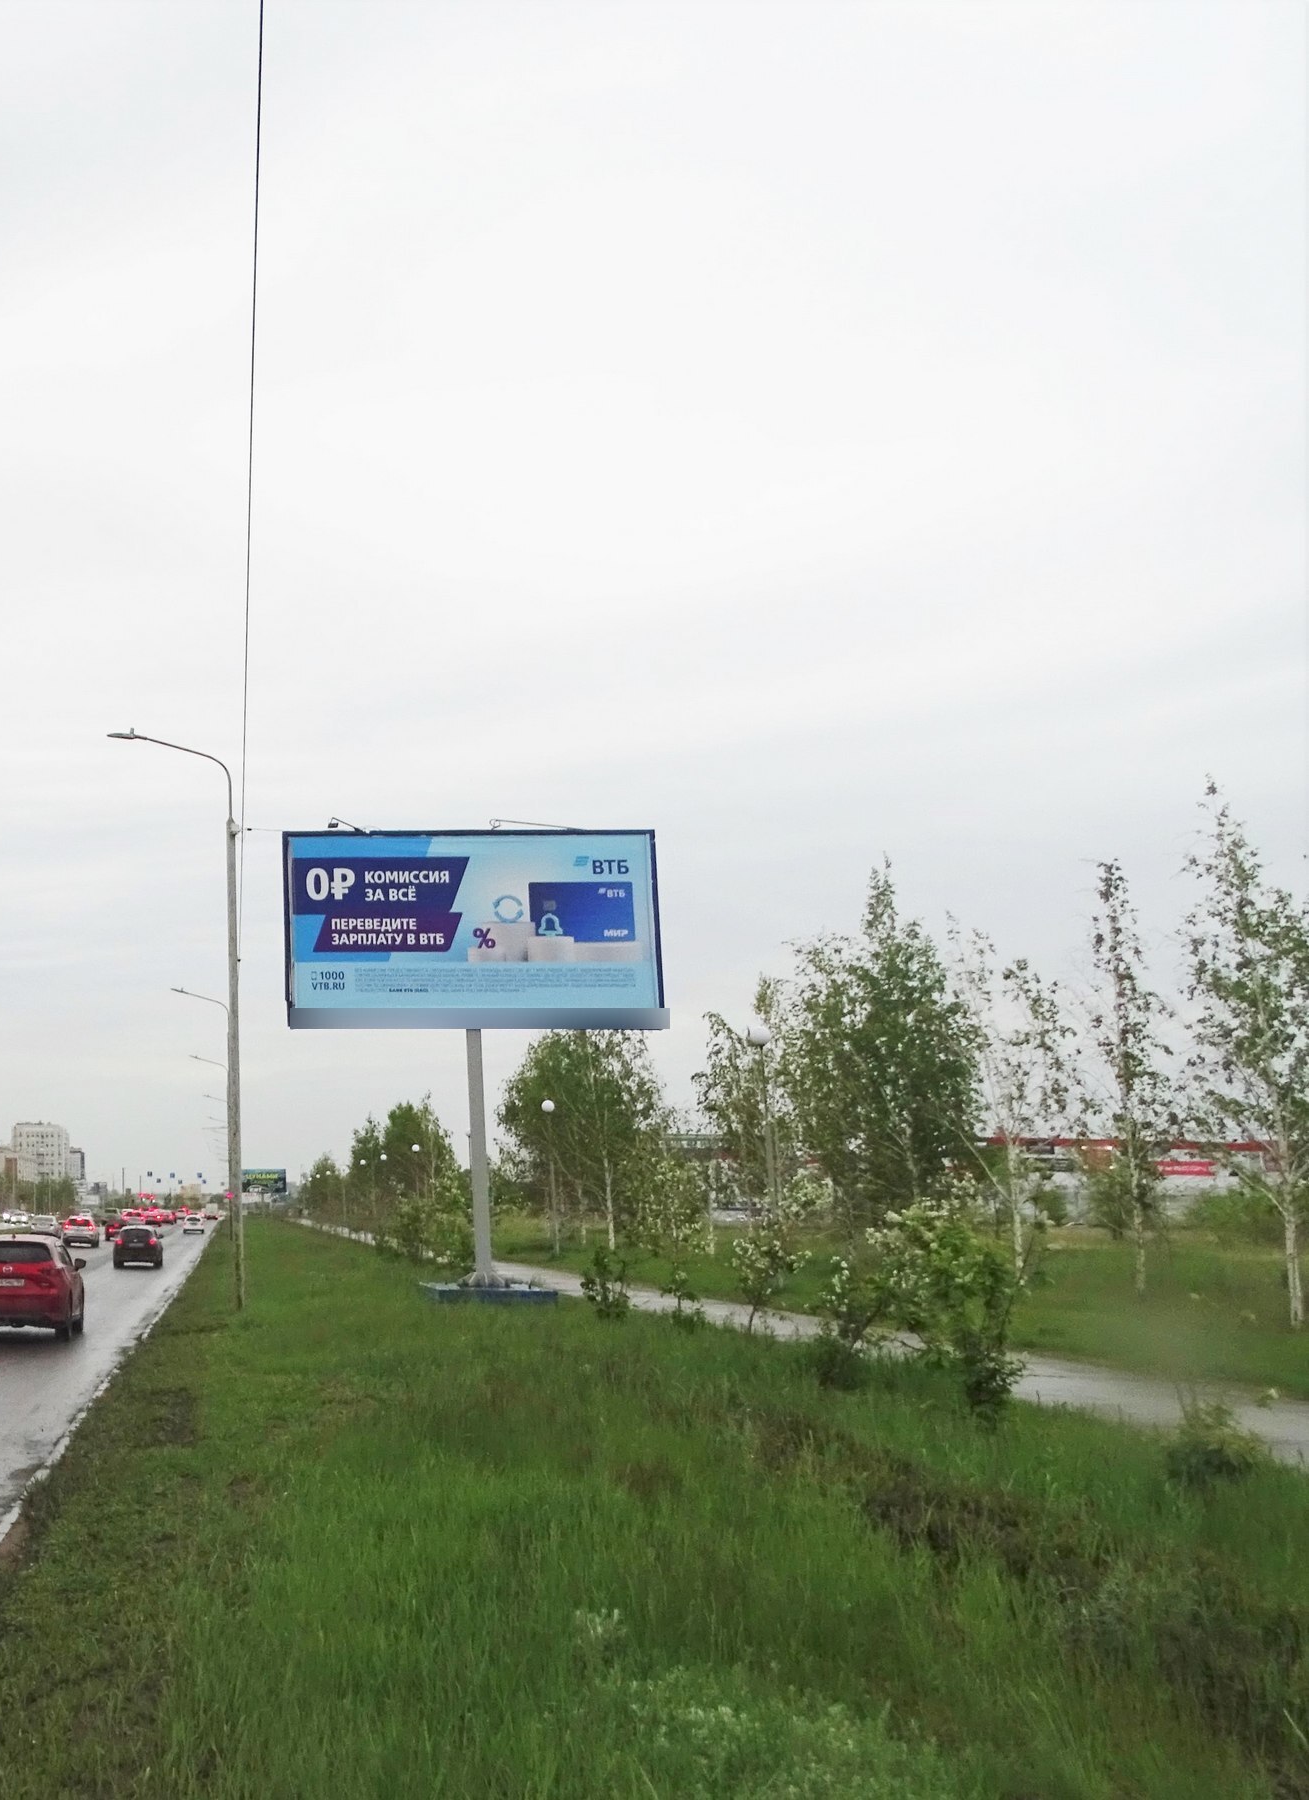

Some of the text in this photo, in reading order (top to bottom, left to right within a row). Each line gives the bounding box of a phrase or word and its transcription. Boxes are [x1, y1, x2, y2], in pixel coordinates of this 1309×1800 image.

[592, 859, 629, 875] ВТБ
[364, 870, 450, 884] КОМИССИЯ
[364, 885, 417, 901] ЗА ВСЁ
[606, 888, 626, 898] ВТБ
[331, 917, 417, 931] ПЕРЕВЕДИТЕ
[331, 932, 445, 946] ЗАРПЛАТУ В ВТБ
[603, 929, 629, 938] МИР
[320, 971, 345, 980] 1000
[312, 982, 345, 990] VTB.RU
